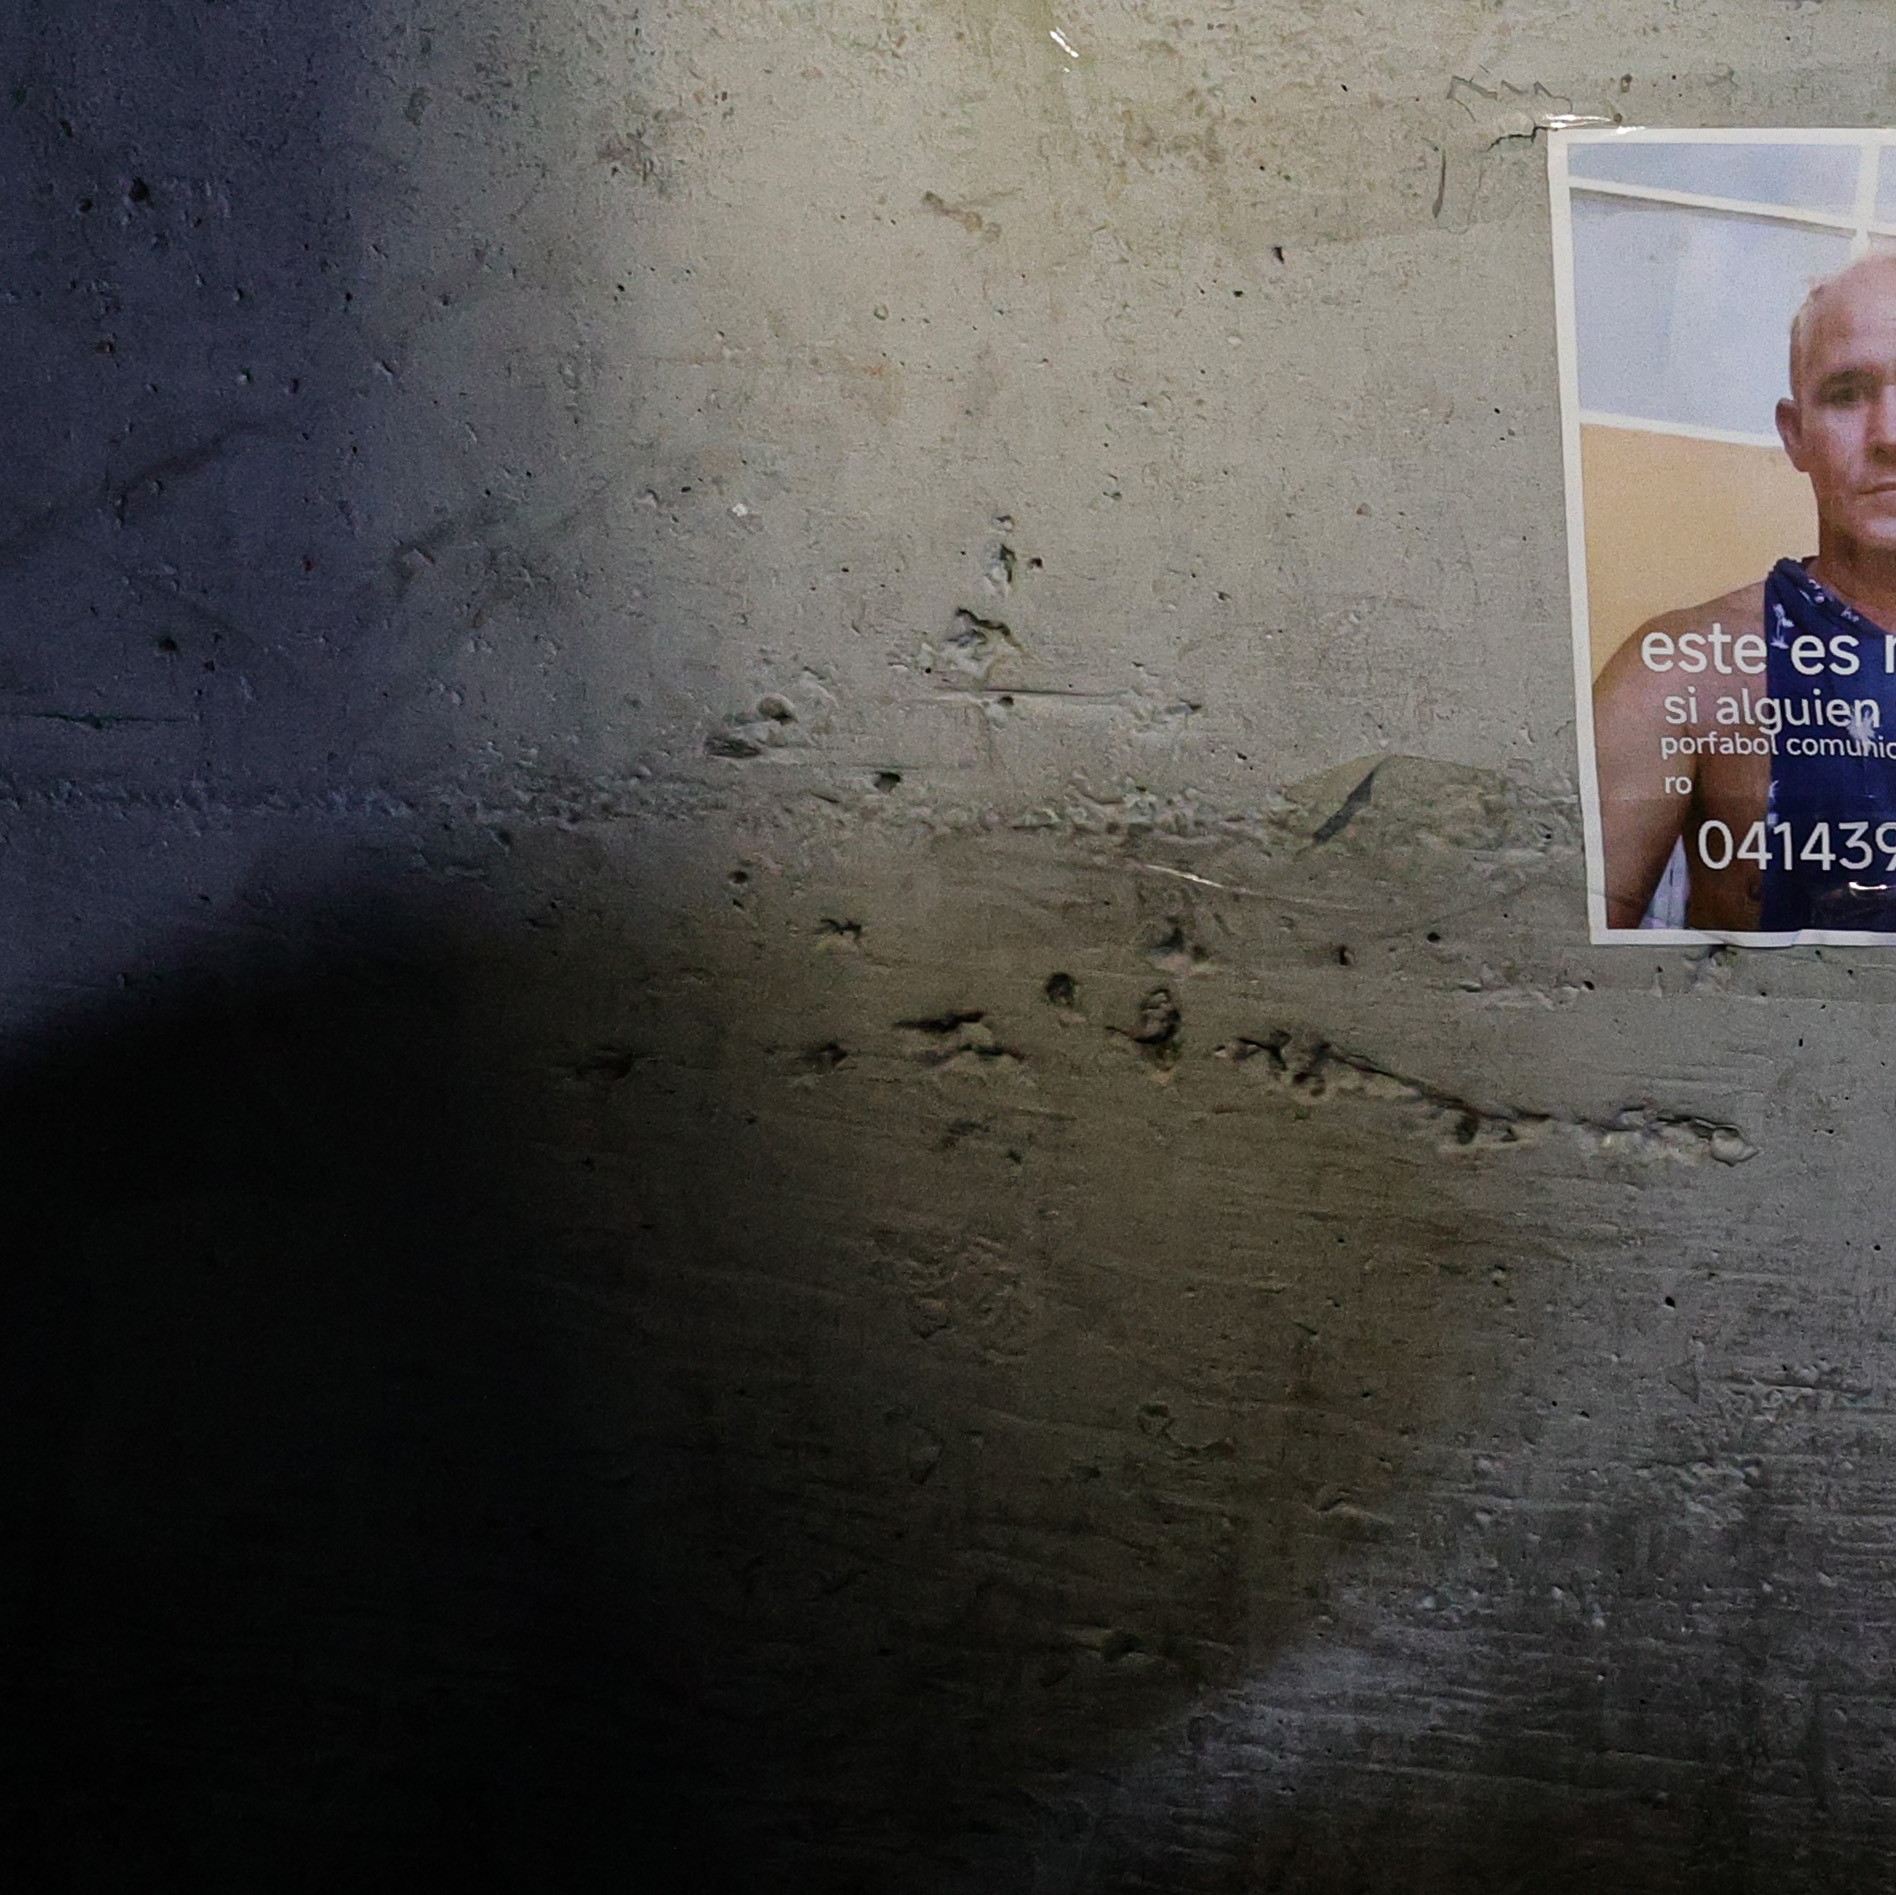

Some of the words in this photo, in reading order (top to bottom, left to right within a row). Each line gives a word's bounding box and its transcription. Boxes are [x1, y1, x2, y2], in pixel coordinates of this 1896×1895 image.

[1641, 622, 1767, 674] este
[1790, 630, 1860, 675] es
[1664, 685, 1697, 724] si
[1715, 688, 1881, 737] alguien
[1660, 730, 1779, 760] porfabol
[1664, 775, 1692, 794] ro
